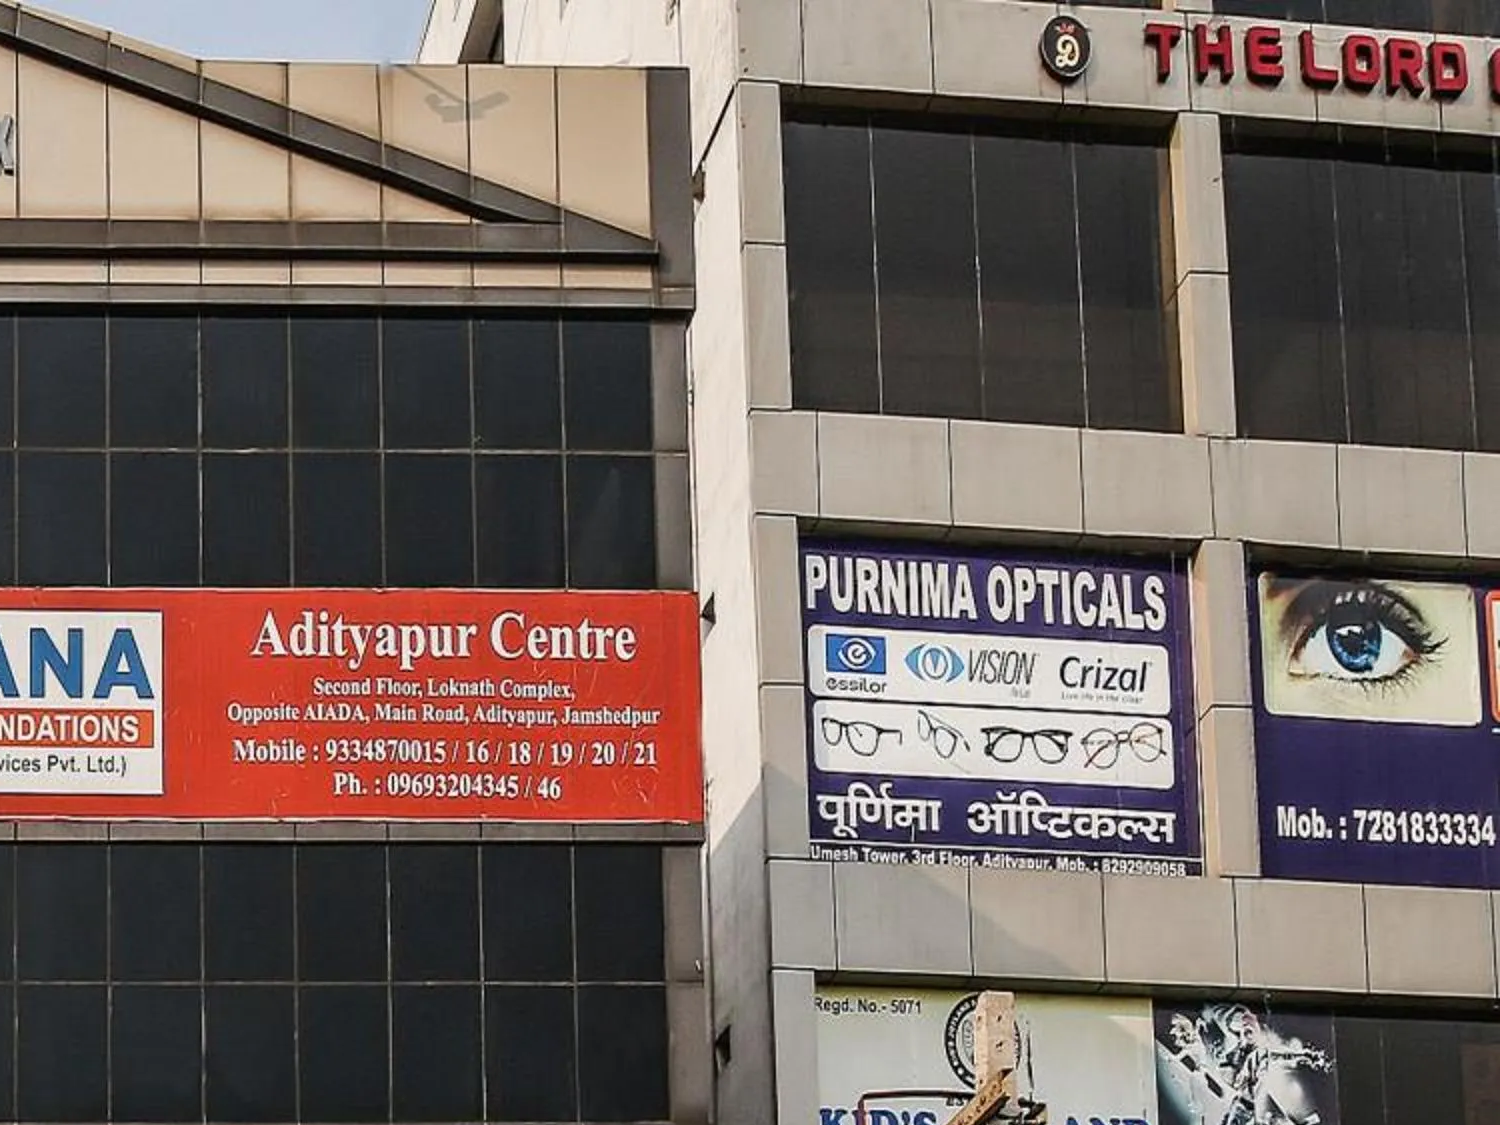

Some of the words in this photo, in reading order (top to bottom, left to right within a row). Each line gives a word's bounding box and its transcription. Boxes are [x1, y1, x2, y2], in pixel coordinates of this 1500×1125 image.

[1145, 23, 1285, 86] THE
[1301, 30, 1469, 99] LORD
[805, 554, 977, 621] PURNIMA
[987, 565, 1167, 631] OPTICALS
[250, 611, 477, 670] Adityapur
[490, 612, 637, 661] Centre
[967, 648, 1036, 685] VISION
[1059, 656, 1148, 693] Crizal
[312, 678, 371, 697] Second
[376, 679, 423, 700] Floor,
[428, 678, 495, 698] Loknath
[500, 680, 576, 702] Complex,
[825, 676, 887, 694] essilor
[227, 703, 301, 724] Opposite
[374, 704, 417, 723] Main
[422, 705, 469, 726] Road,
[472, 706, 557, 728] Adityapur,
[560, 707, 660, 728] Jamshedpur
[46, 754, 81, 773] Pvt.
[87, 753, 127, 777] Ltd.)
[233, 740, 306, 762] Mobile
[325, 740, 447, 764] 9334870015
[465, 741, 489, 764] 16
[508, 742, 531, 764] 18
[550, 742, 573, 766] 19
[592, 742, 616, 765] 20
[634, 743, 657, 766] 21
[333, 773, 368, 796] Ph.
[386, 773, 519, 798] 09693204345
[537, 775, 562, 799] 46
[816, 781, 942, 839] पूर्णिमा
[967, 788, 1177, 845] ऑप्टिकल्स
[1276, 805, 1333, 840] Mob.
[1353, 808, 1496, 847] 7281833334
[811, 845, 858, 861] Umesh
[912, 850, 935, 865] 3rd
[814, 997, 854, 1015] Regd.
[890, 999, 922, 1015] 5071
